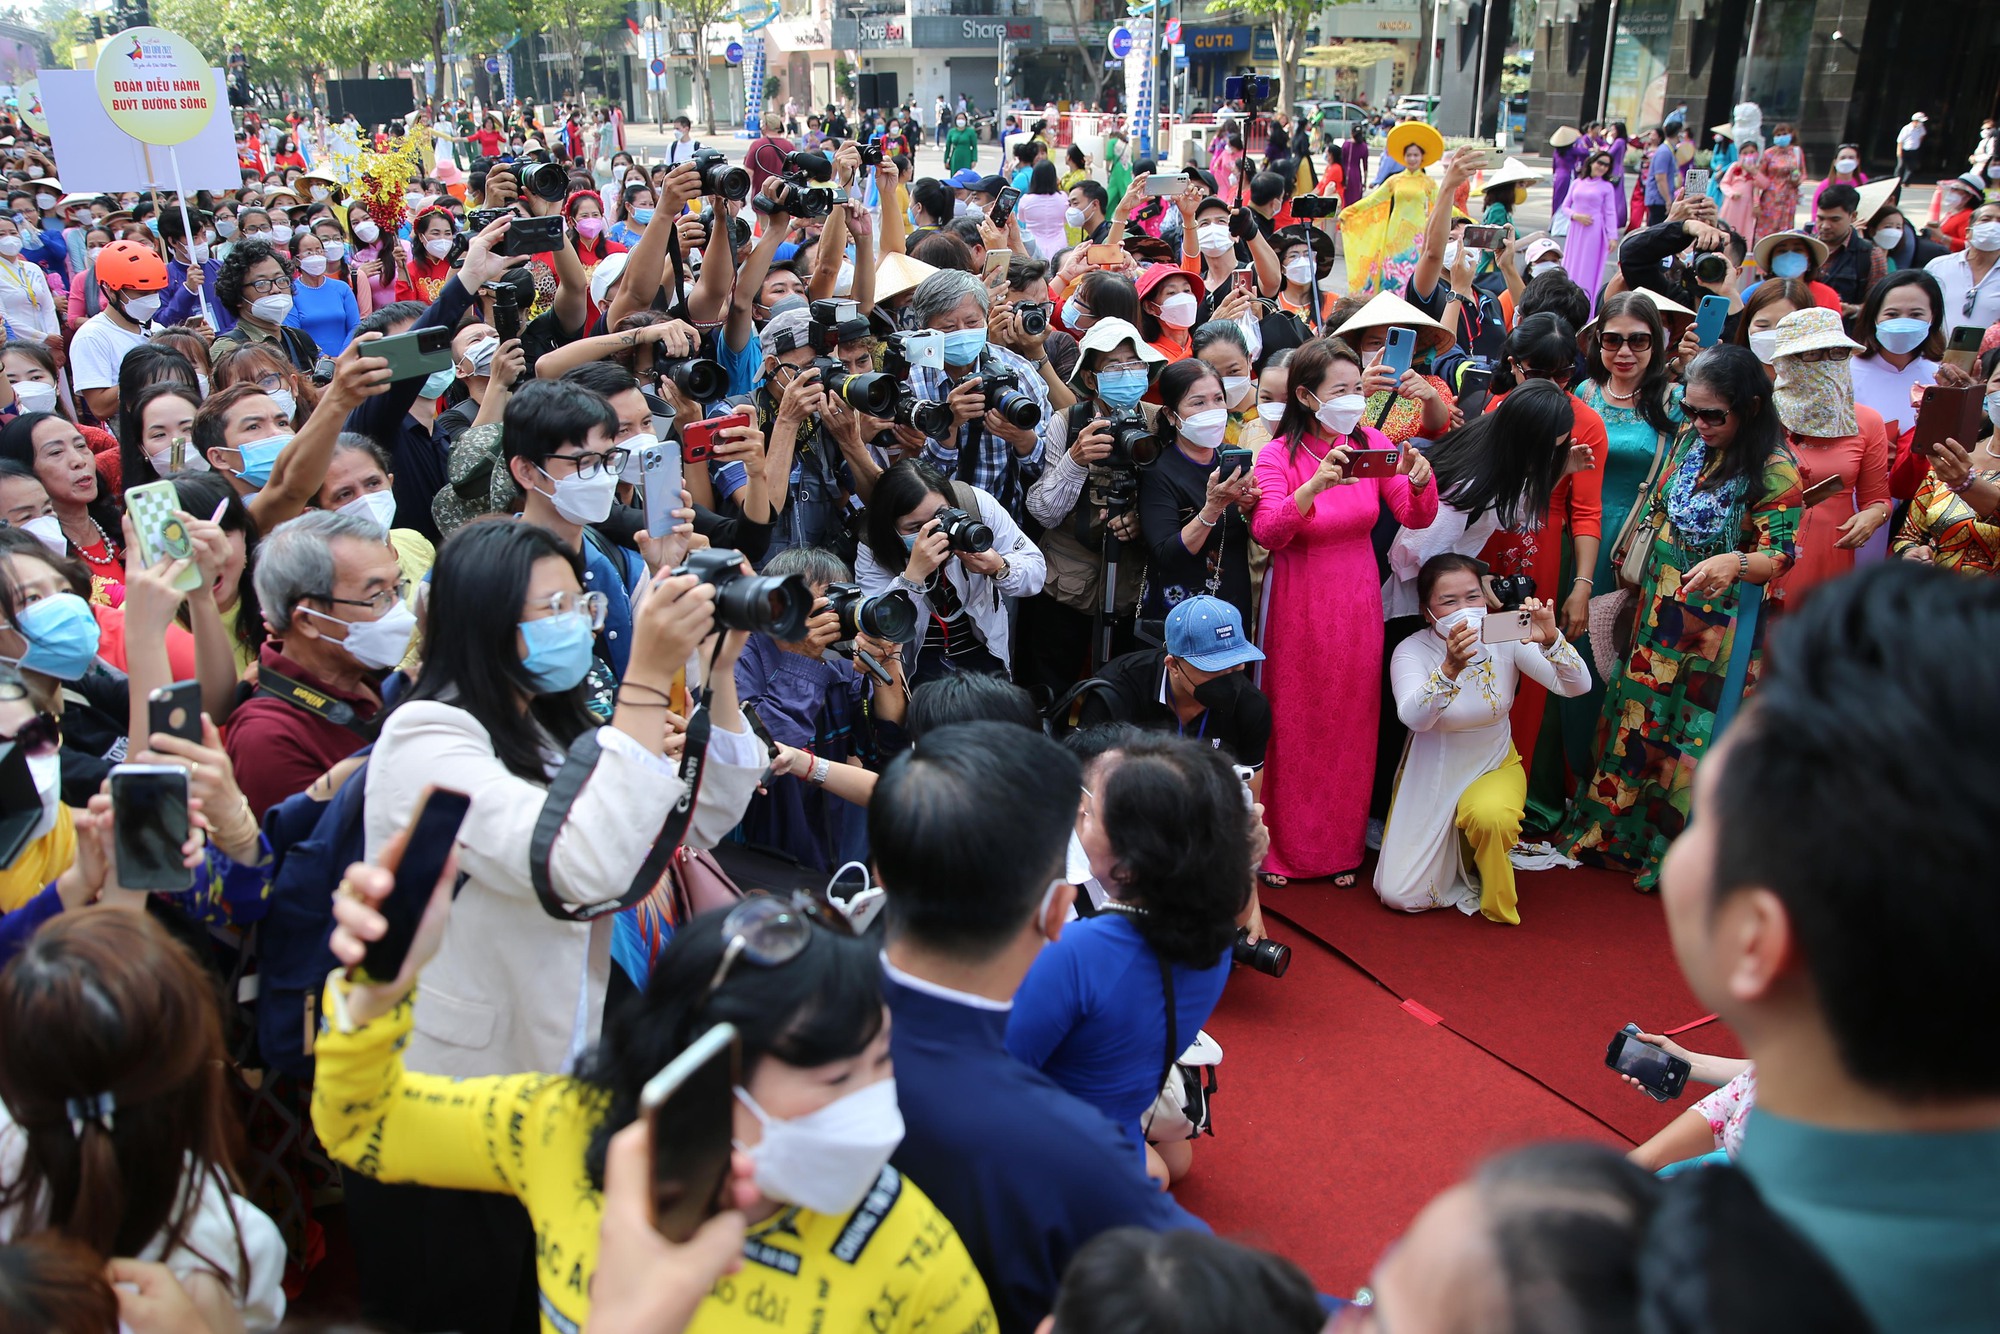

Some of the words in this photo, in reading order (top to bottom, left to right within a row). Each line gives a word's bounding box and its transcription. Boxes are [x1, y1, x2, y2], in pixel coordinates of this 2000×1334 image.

[963, 19, 1031, 39] Sharetea
[1195, 34, 1234, 48] GUTA
[113, 79, 143, 93] ĐOÀN
[172, 78, 201, 92] HÀNH
[142, 97, 177, 110] ĐƯỜNG
[180, 96, 207, 109] SÔNG
[292, 687, 327, 709] Nikon
